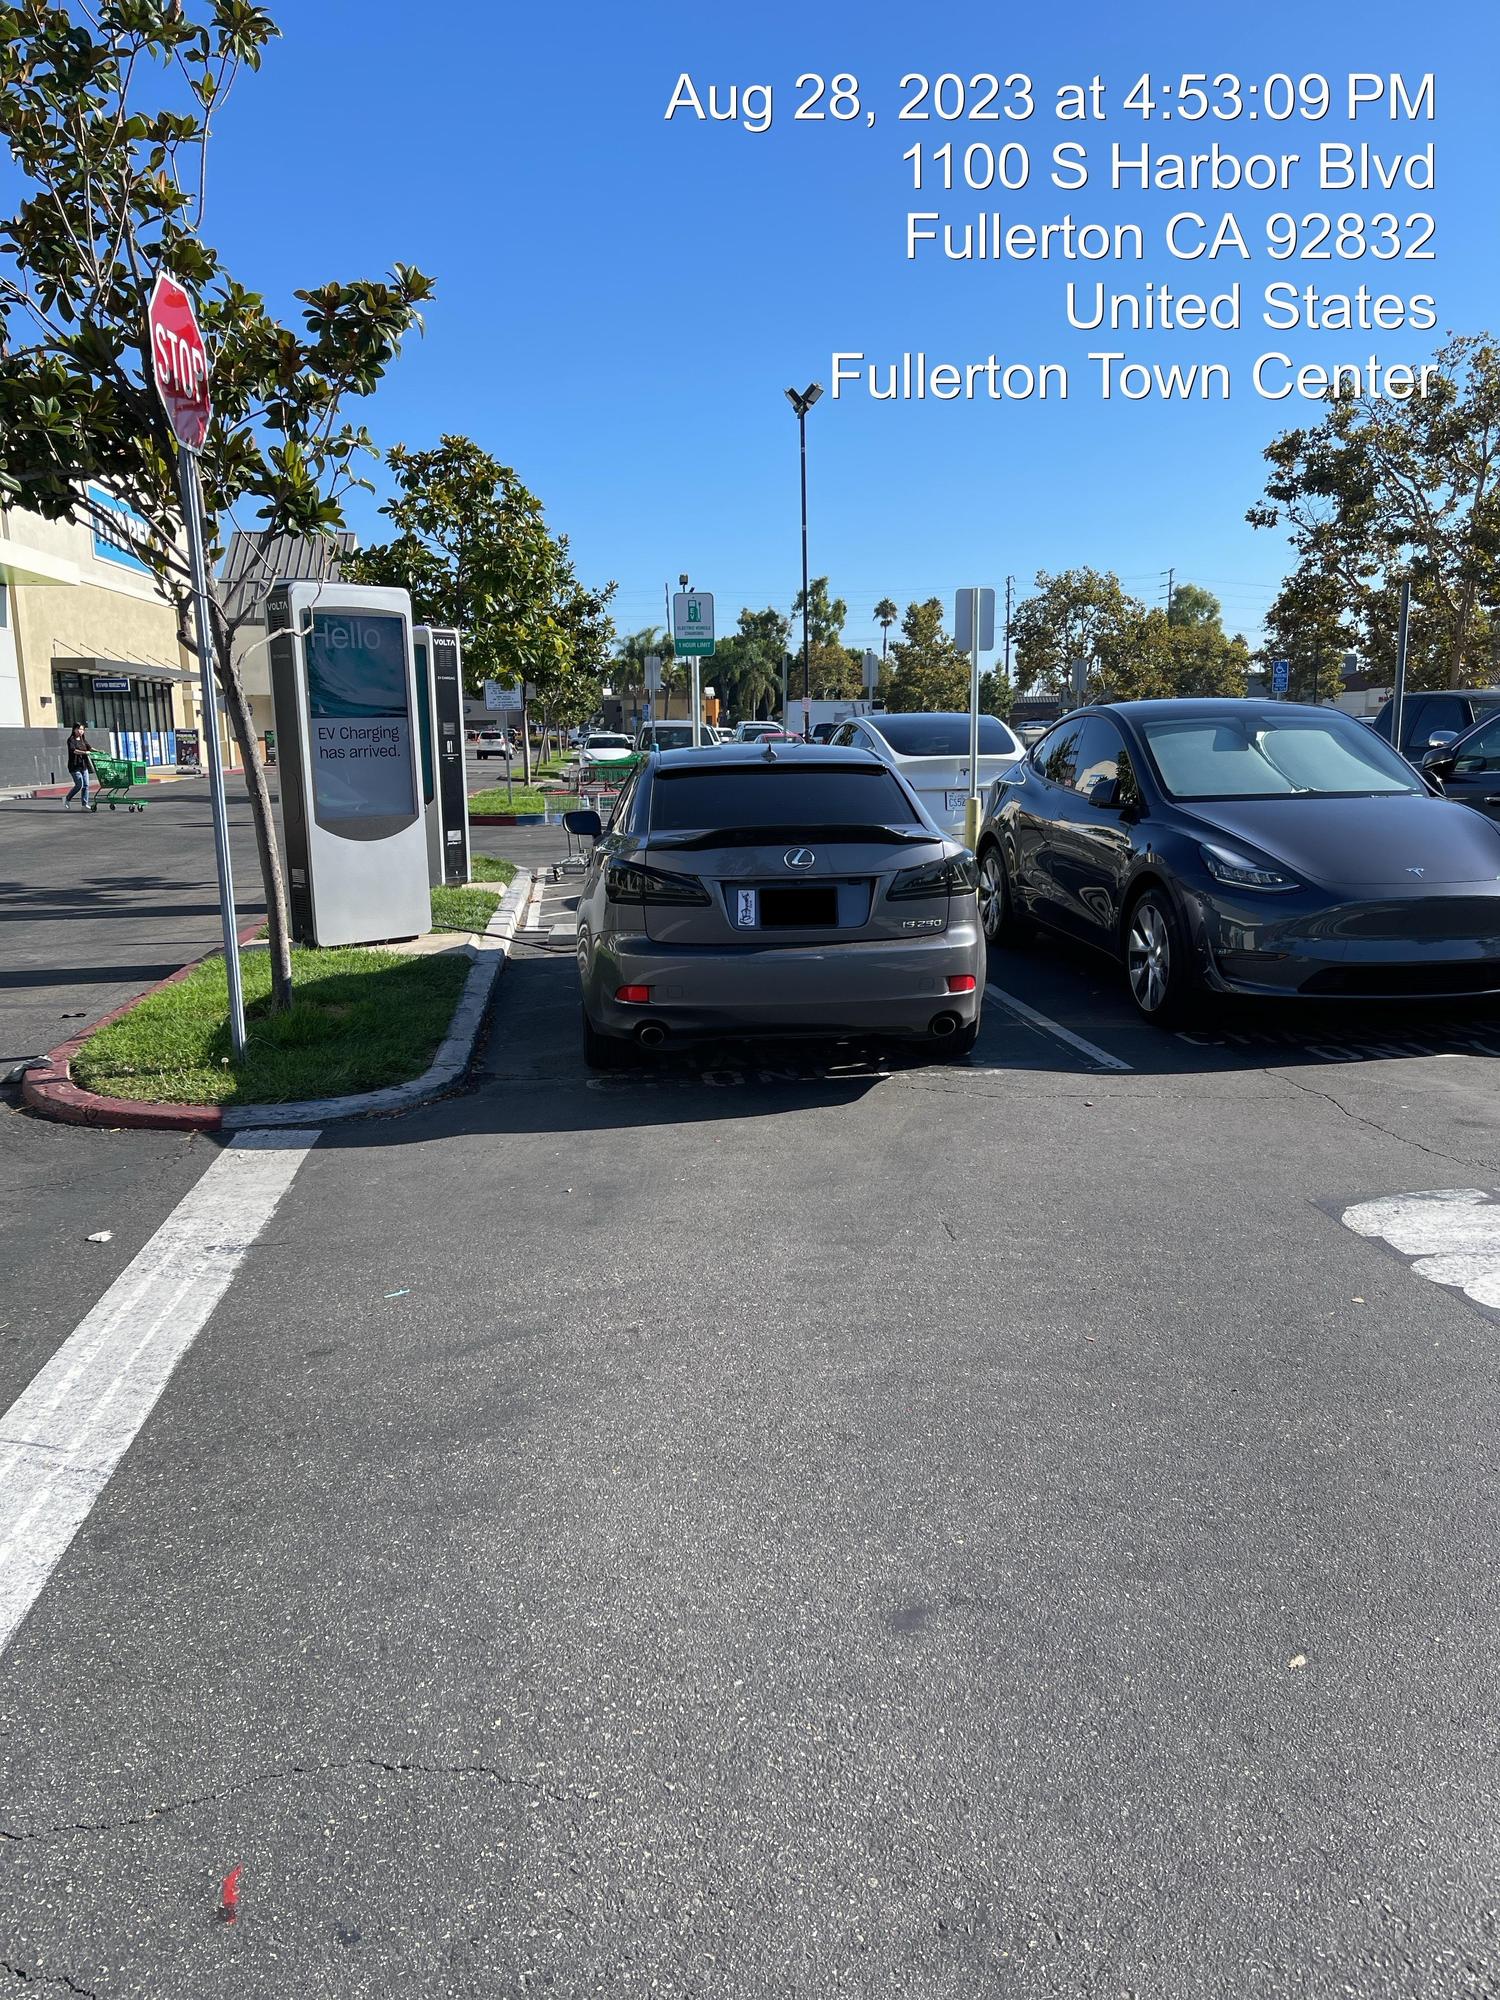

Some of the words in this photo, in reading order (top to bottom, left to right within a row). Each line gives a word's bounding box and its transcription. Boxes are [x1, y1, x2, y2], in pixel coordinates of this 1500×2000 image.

[155, 322, 205, 403] STOP
[267, 601, 289, 611] VOLTA
[311, 621, 381, 650] Hello
[318, 727, 336, 740] EV
[340, 725, 400, 743] Charging
[320, 745, 346, 759] has
[349, 744, 401, 758] arrived.
[902, 920, 916, 928] IS
[917, 919, 942, 928] 250
